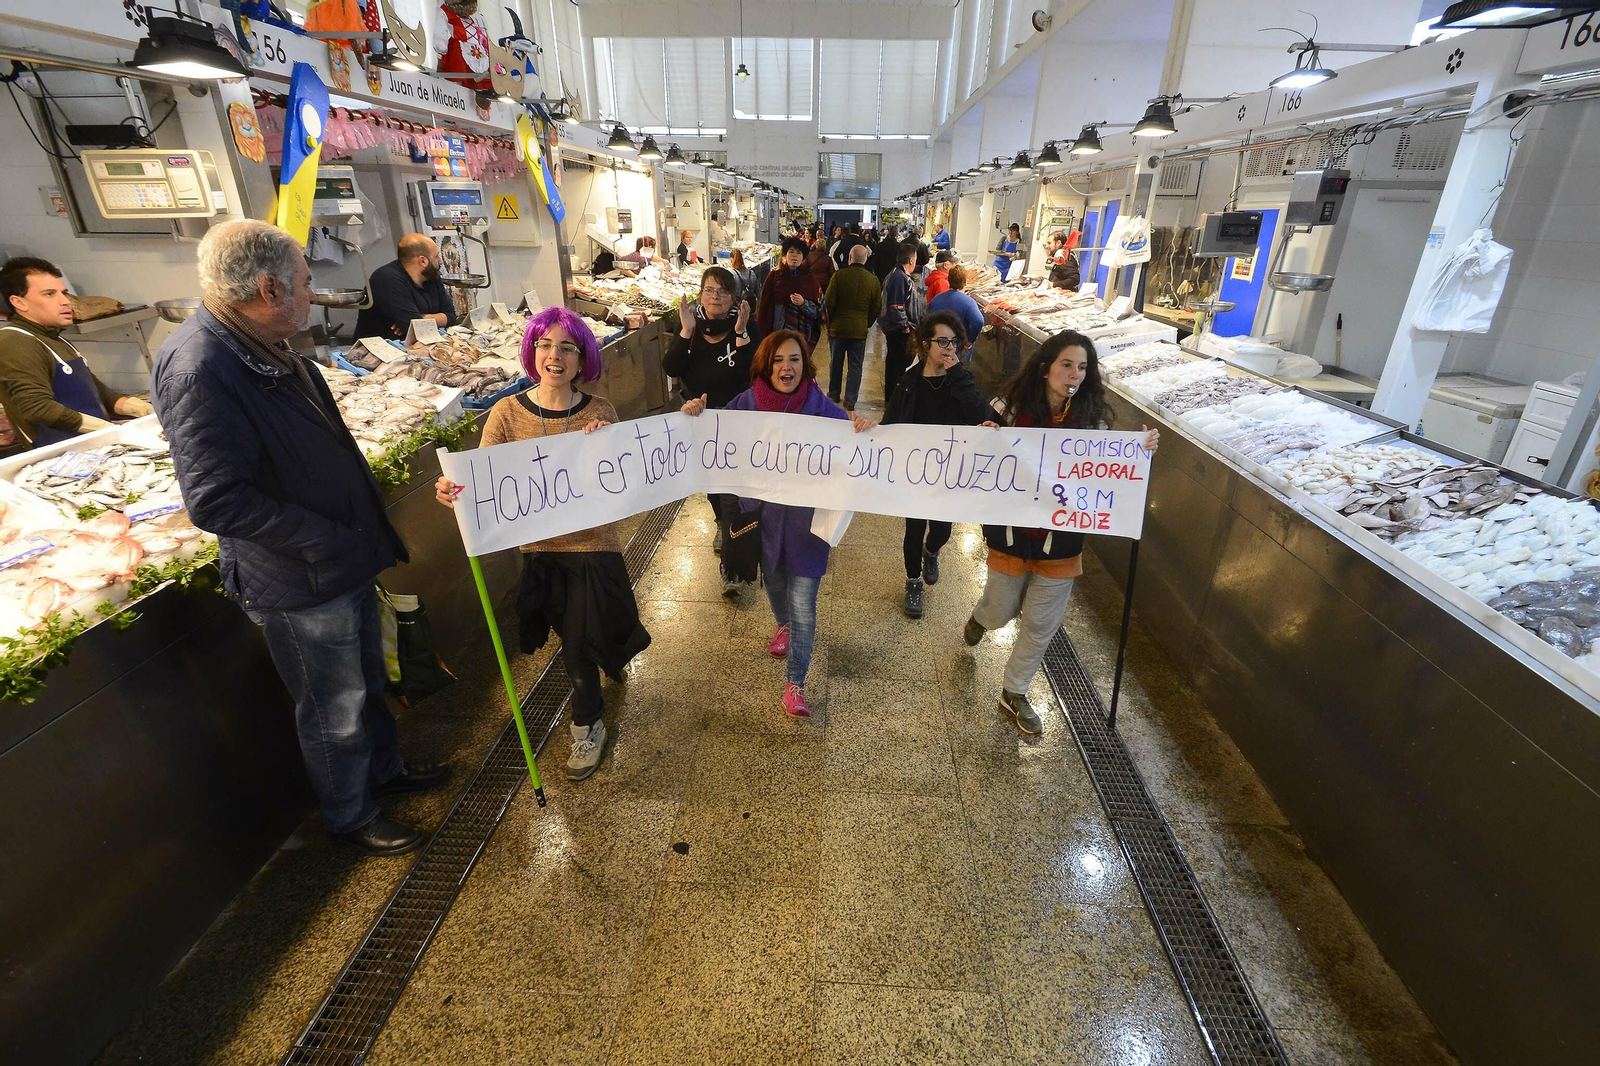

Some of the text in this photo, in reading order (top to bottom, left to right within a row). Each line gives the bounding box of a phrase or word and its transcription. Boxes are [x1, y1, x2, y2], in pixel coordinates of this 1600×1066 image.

[389, 72, 466, 111] Juan de Micaela
[1281, 88, 1304, 112] 166
[470, 445, 583, 530] Hasta
[598, 452, 632, 494] er
[635, 418, 692, 485] toto
[701, 413, 738, 470] de
[749, 439, 841, 476] currar
[846, 438, 895, 484] sin
[1057, 461, 1144, 481] LABORAL
